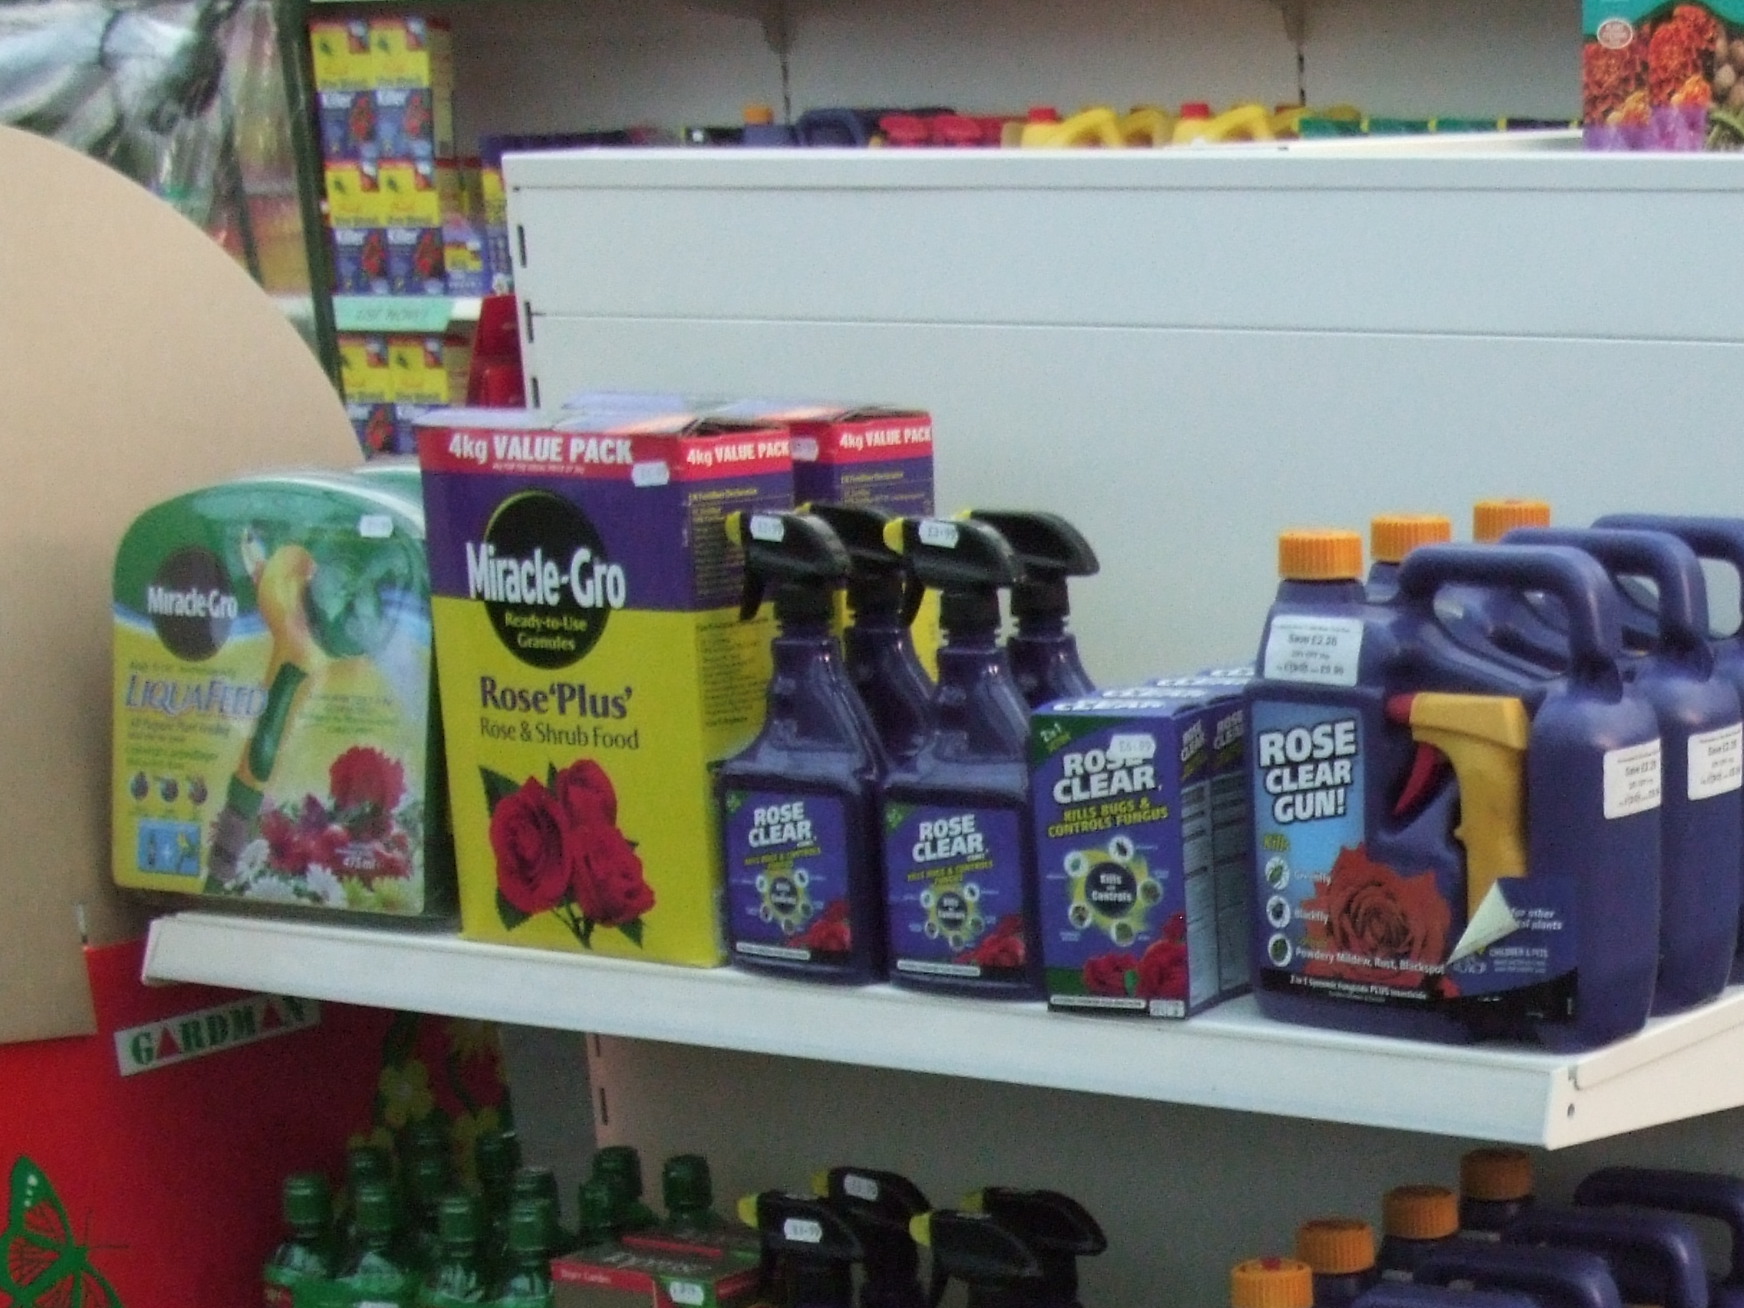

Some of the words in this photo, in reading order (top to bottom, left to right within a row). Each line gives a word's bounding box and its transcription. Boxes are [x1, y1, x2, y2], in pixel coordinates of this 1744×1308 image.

[449, 437, 488, 464] 4kg
[492, 435, 565, 461] VALUE
[570, 437, 633, 465] PACK
[840, 432, 864, 450] 4kg
[865, 429, 900, 447] VALUE
[903, 425, 931, 443] PACK
[687, 448, 713, 467] 4kg
[715, 444, 755, 462] VALUE
[757, 440, 790, 460] PACK
[466, 543, 626, 609] Miracle-Gro
[148, 586, 238, 619] Miracle-Gro
[505, 613, 588, 633] Ready-to-Use
[517, 633, 576, 653] Granules
[481, 718, 516, 740] Rose
[520, 722, 530, 742] &
[535, 721, 588, 747] Shrub
[593, 725, 639, 749] Food
[1259, 720, 1357, 767] ROSE
[1053, 765, 1155, 804] CLEAR
[1266, 759, 1353, 794] CLEAR
[754, 802, 805, 827] ROSE
[1064, 806, 1096, 822] KILLS
[1101, 799, 1135, 816] BUGS
[1140, 797, 1149, 810] &
[1274, 788, 1346, 824] GUN!
[749, 820, 812, 848] CLEAR
[919, 814, 975, 842] ROSE
[1047, 816, 1112, 838] CONTROLS
[1116, 807, 1169, 827] FUNGUS
[912, 833, 983, 863] CLEAR
[1295, 948, 1334, 965] Powdery
